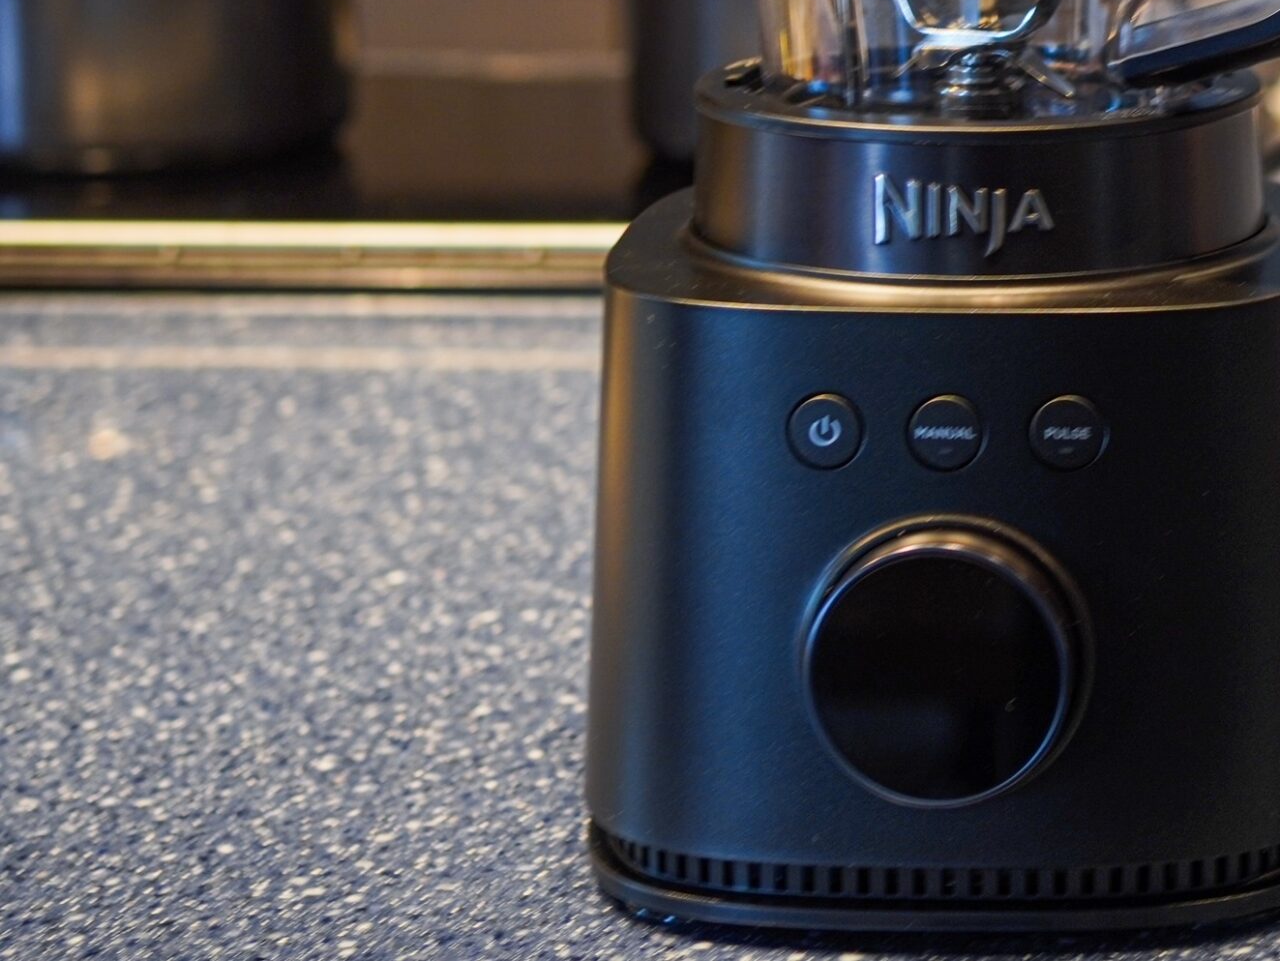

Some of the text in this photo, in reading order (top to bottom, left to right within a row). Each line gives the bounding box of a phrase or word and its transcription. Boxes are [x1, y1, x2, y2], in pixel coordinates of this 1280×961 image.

[874, 173, 1056, 259] NINJA
[914, 425, 978, 441] MANUAL
[1043, 426, 1093, 441] PULSE
